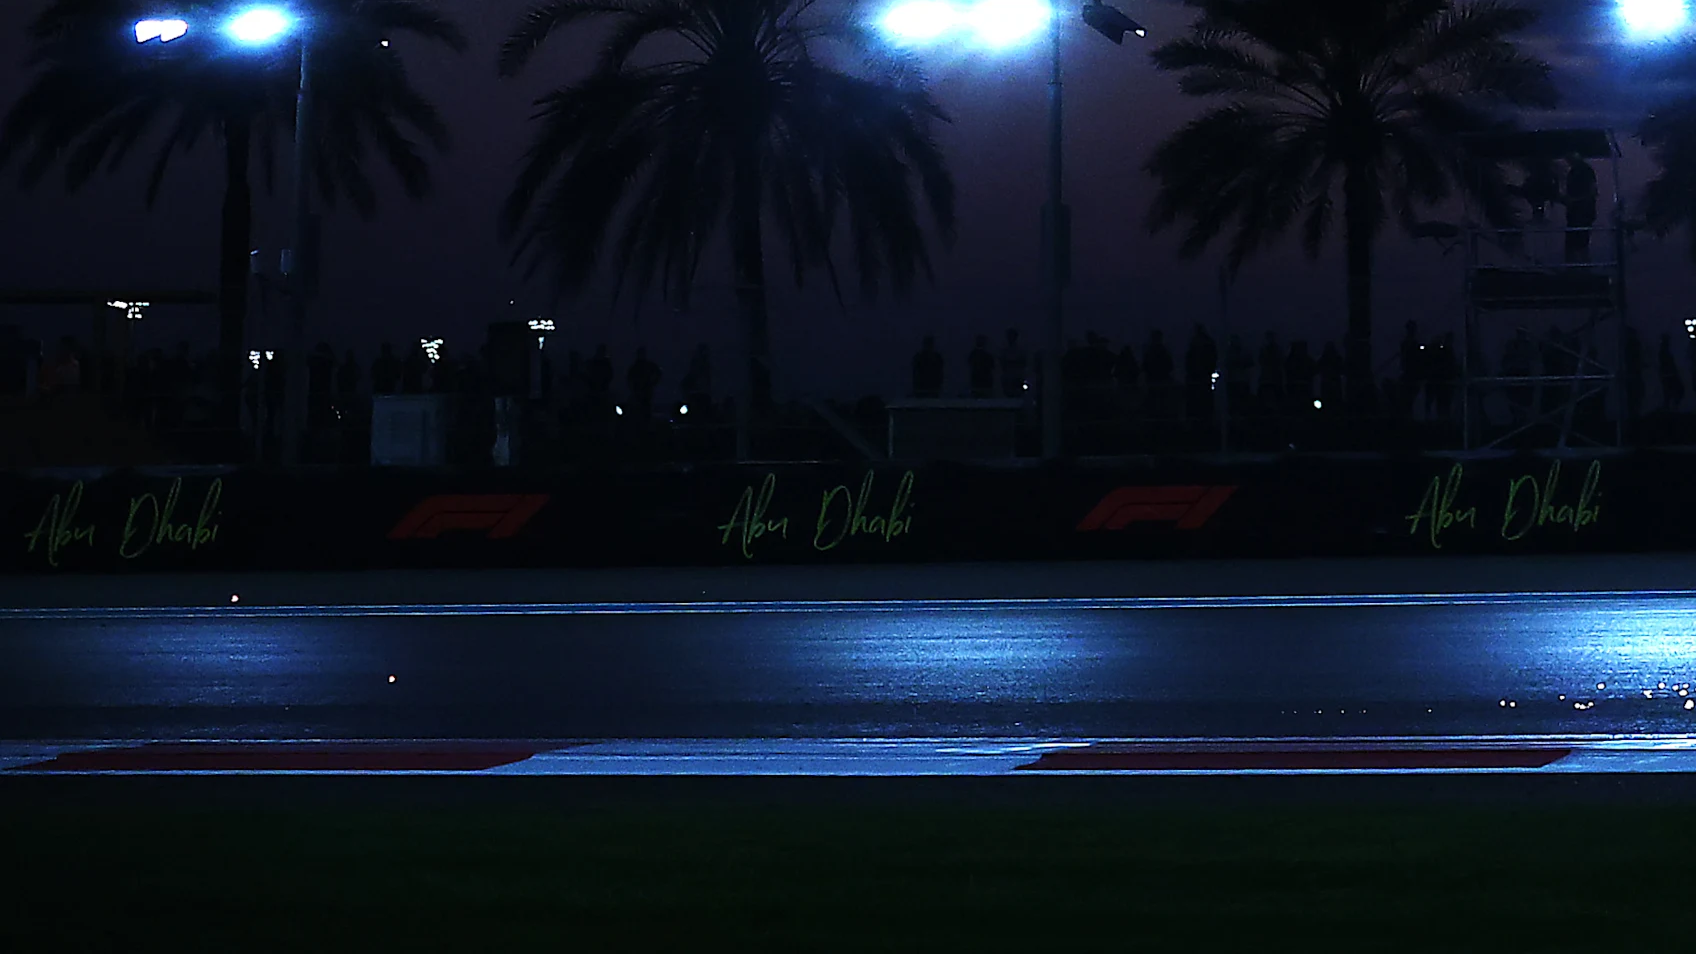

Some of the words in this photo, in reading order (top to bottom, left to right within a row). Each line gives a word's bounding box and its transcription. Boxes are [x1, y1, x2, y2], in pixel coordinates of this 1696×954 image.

[26, 480, 96, 567] Abu
[118, 476, 224, 559] Dhabi
[718, 473, 788, 559] Abu
[813, 469, 916, 551] Dhabi
[1404, 462, 1477, 548] Abu
[1500, 458, 1602, 540] Dhabi
